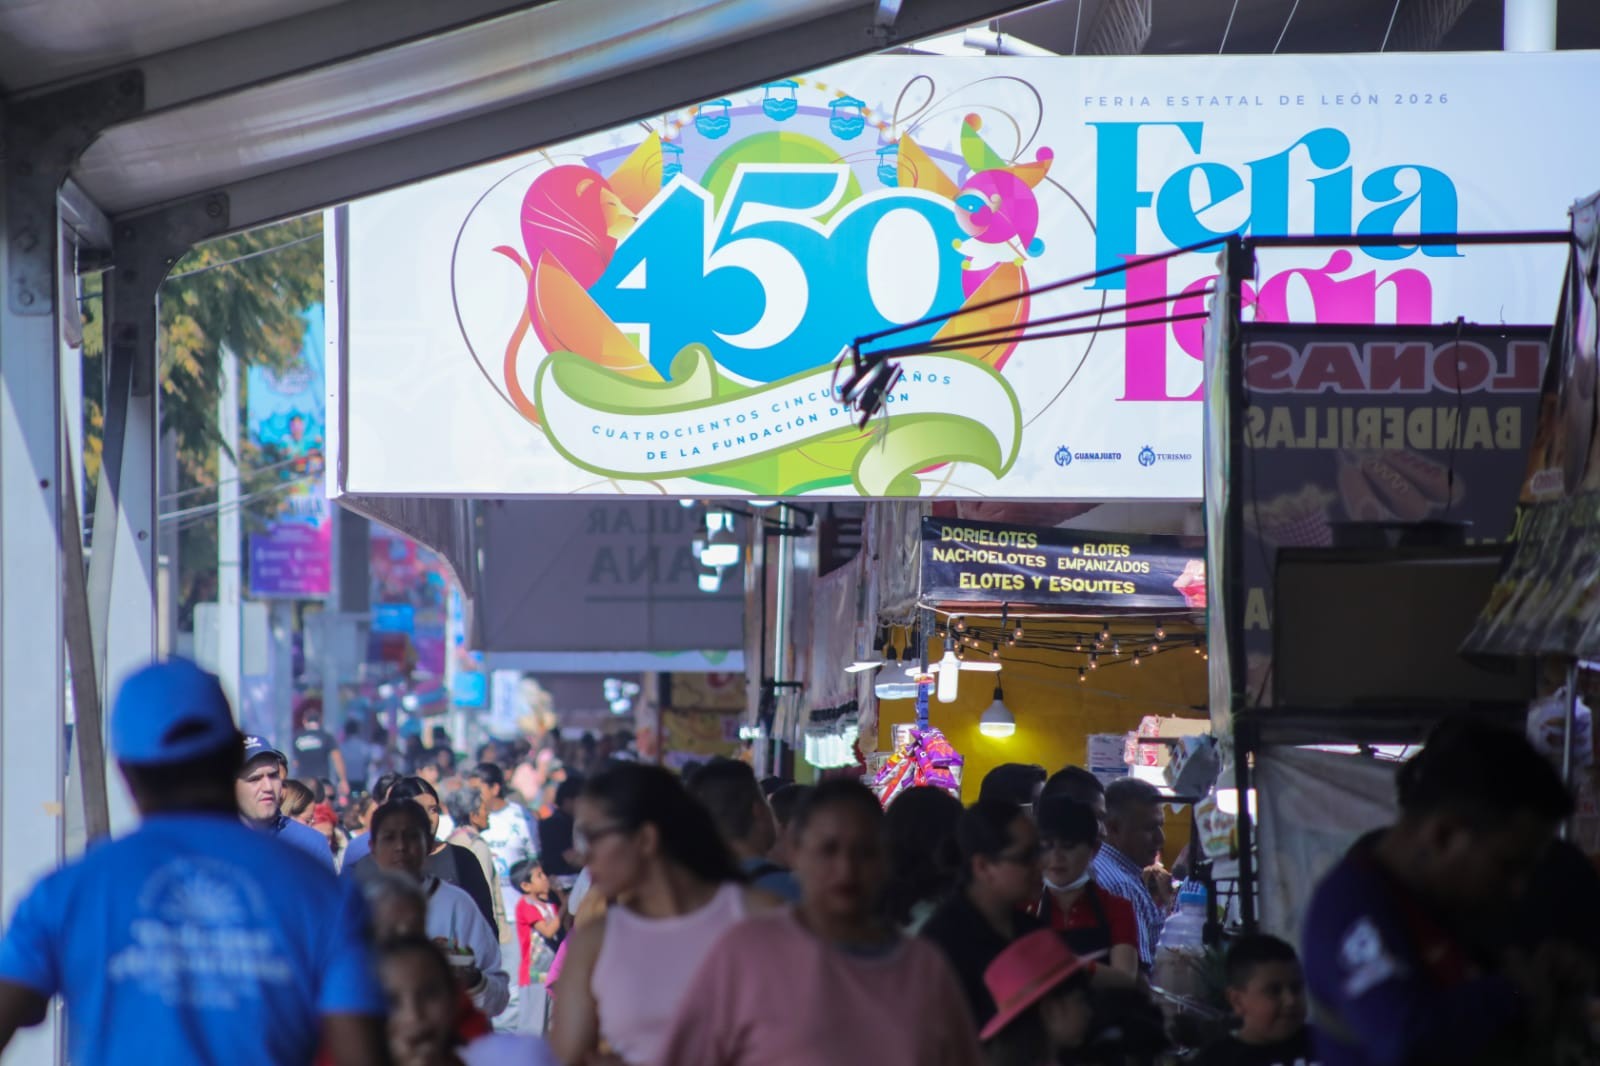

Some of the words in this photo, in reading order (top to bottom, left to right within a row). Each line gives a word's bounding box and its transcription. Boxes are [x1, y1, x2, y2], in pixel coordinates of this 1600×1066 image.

[1084, 95, 1151, 107] FERIA
[1166, 94, 1264, 107] ESTATAL
[1279, 94, 1304, 106] DE
[1321, 91, 1379, 106] LEÓN
[1394, 93, 1449, 105] 2026
[1084, 121, 1465, 290] Feria
[587, 164, 970, 386] 450
[591, 410, 759, 441] CUATROCIENTOS
[771, 384, 844, 413] CINCUE
[897, 370, 951, 385] AÑOS
[647, 450, 668, 461] DE
[680, 446, 701, 457] LA
[712, 413, 818, 451] FUNDACIÓN
[1074, 452, 1122, 460] GUANAJUATO
[1157, 453, 1192, 461] TURISMO
[941, 525, 1038, 549] DORIELOTES
[931, 546, 1047, 568] NACHOELOTES
[1083, 543, 1130, 558] ELOTES
[1057, 557, 1150, 574] EMPANIZADOS
[959, 571, 1025, 591] ELOTES
[1032, 575, 1042, 590] Y
[1048, 576, 1136, 595] ESQUITES
